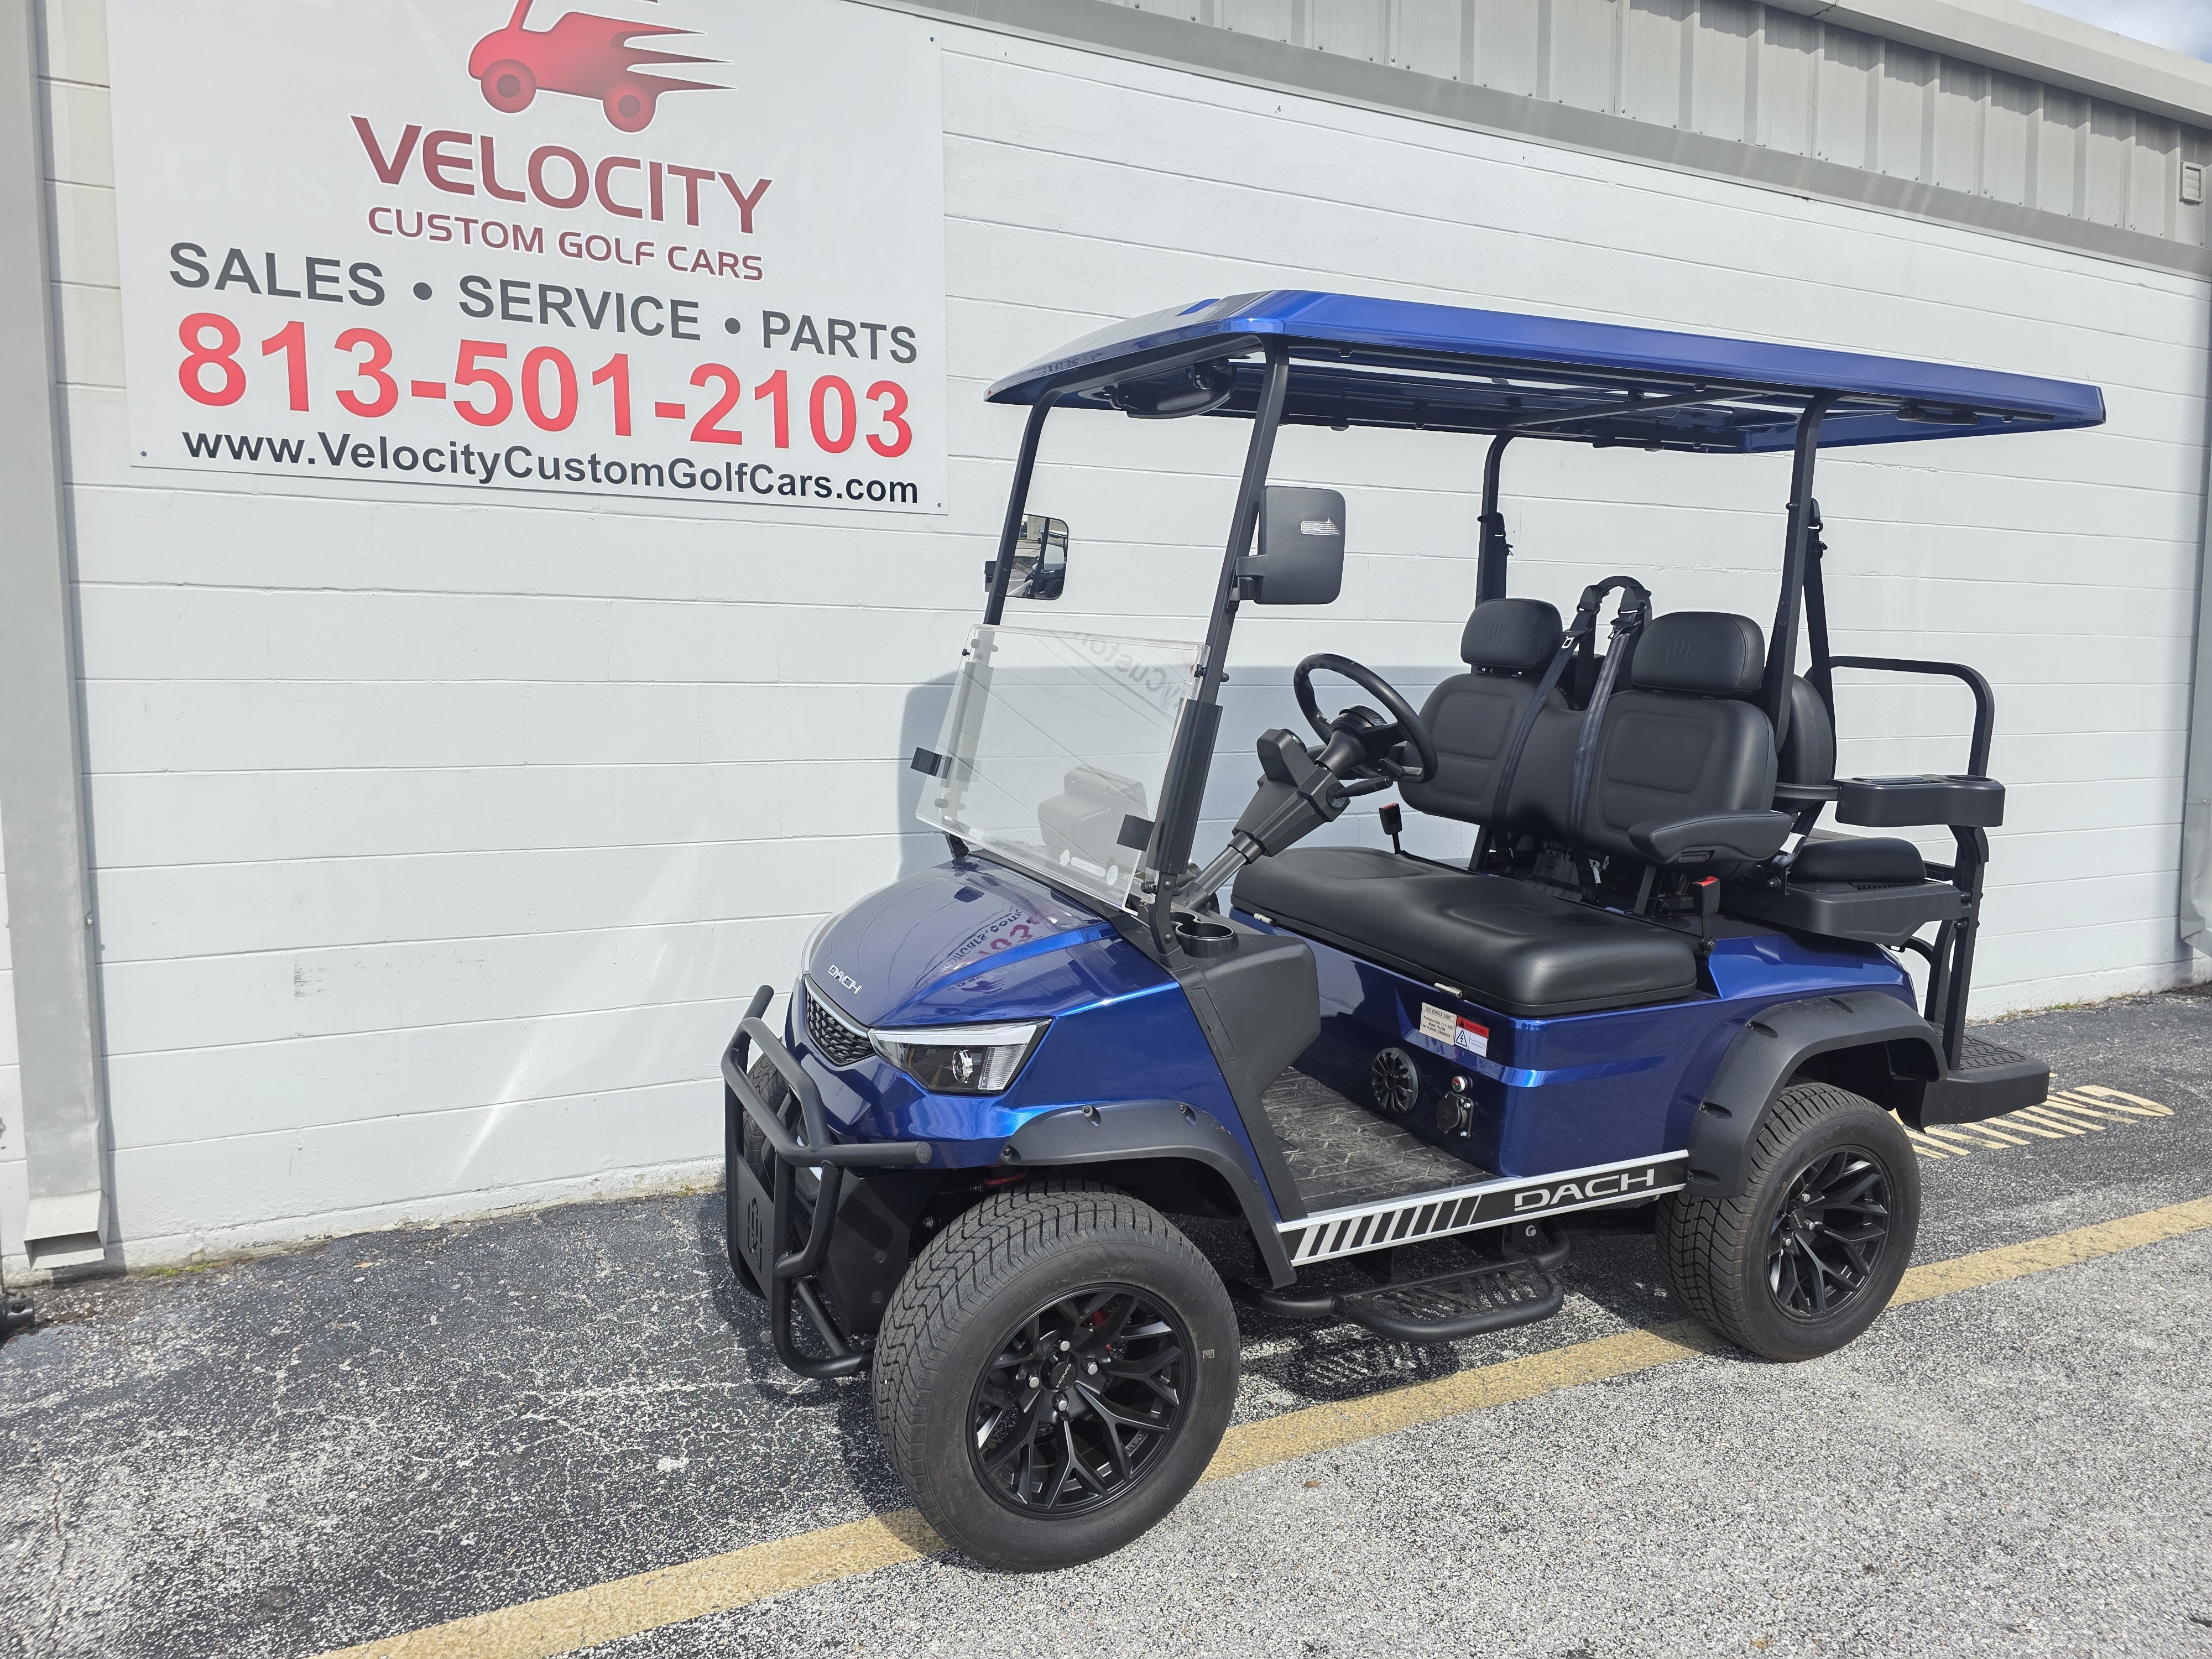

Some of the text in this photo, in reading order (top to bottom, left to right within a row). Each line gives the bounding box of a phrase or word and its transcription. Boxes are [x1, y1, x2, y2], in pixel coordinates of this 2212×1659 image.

[350, 116, 772, 233] VELOCITY
[369, 207, 543, 253] CUSTOM
[559, 232, 654, 265] GOLF
[668, 246, 762, 280] CARS
[170, 243, 916, 363] SALES SERVICE PARTS
[178, 312, 913, 458] 813-501-2103
[182, 432, 917, 505] www.VelocityCustomGolfCars.com
[827, 964, 863, 994] DACH
[1465, 1023, 1486, 1035] WARNING
[1514, 1168, 1655, 1212] DACH
